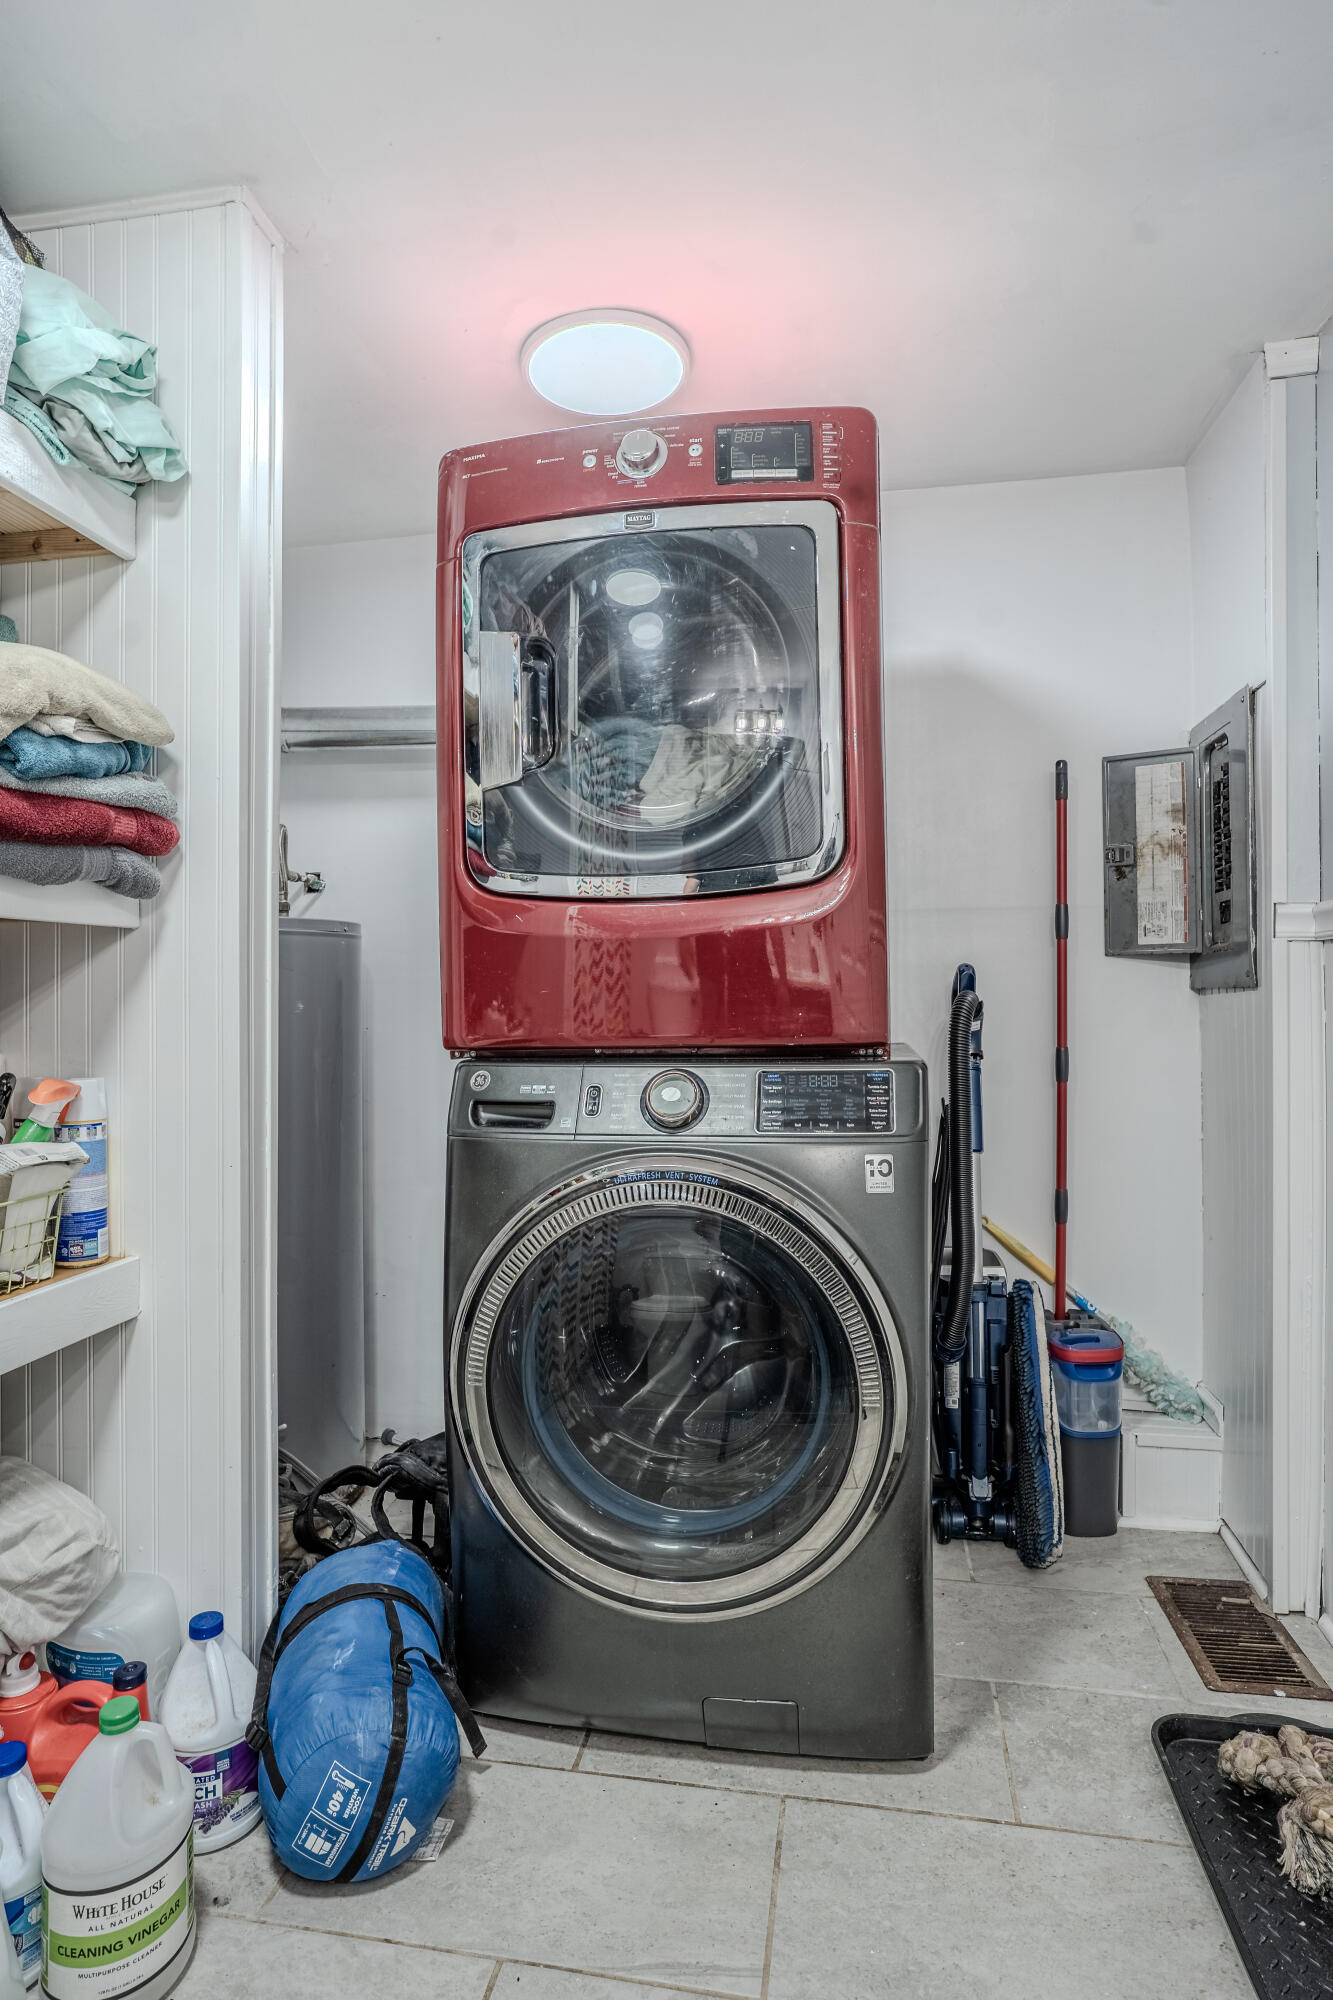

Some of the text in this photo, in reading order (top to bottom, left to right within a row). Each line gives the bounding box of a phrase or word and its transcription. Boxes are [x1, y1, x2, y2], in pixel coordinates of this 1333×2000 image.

[463, 453, 486, 462] MAXIMA
[664, 1171, 685, 1180] VENT
[689, 1173, 719, 1186] SYSTEM
[866, 1159, 893, 1178] 10
[343, 1788, 360, 1819] WEATHER
[351, 1796, 362, 1815] COOL
[57, 1899, 181, 1959] CLEANING VINEGAR
[88, 1924, 105, 1933] ALL
[110, 1903, 154, 1928] NATURAL
[77, 1941, 163, 1980] MULTIPURPOSE CLEANER
